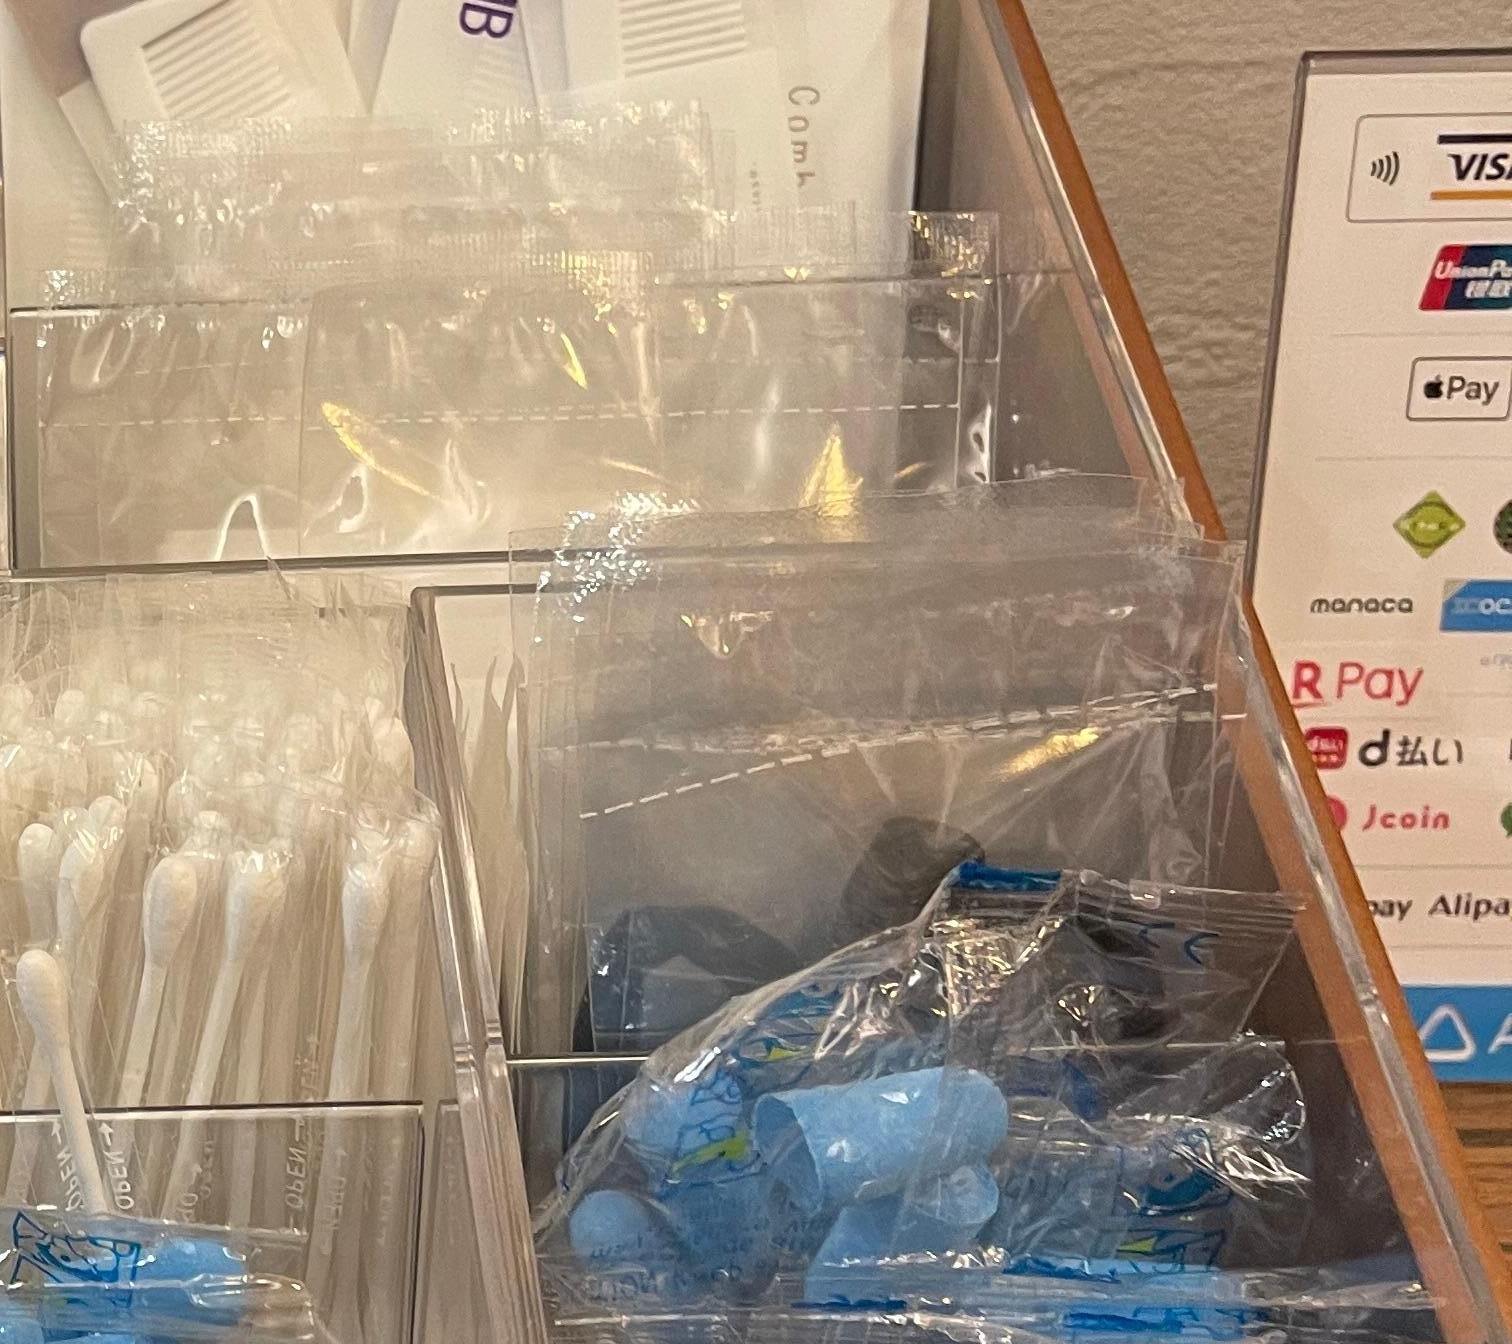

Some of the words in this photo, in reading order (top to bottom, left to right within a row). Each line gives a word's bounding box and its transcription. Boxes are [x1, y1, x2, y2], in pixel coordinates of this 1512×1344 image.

[1447, 375, 1500, 406] Pay
[1310, 598, 1414, 614] manaca
[1337, 662, 1424, 706] Pay
[1358, 728, 1463, 767] d払い
